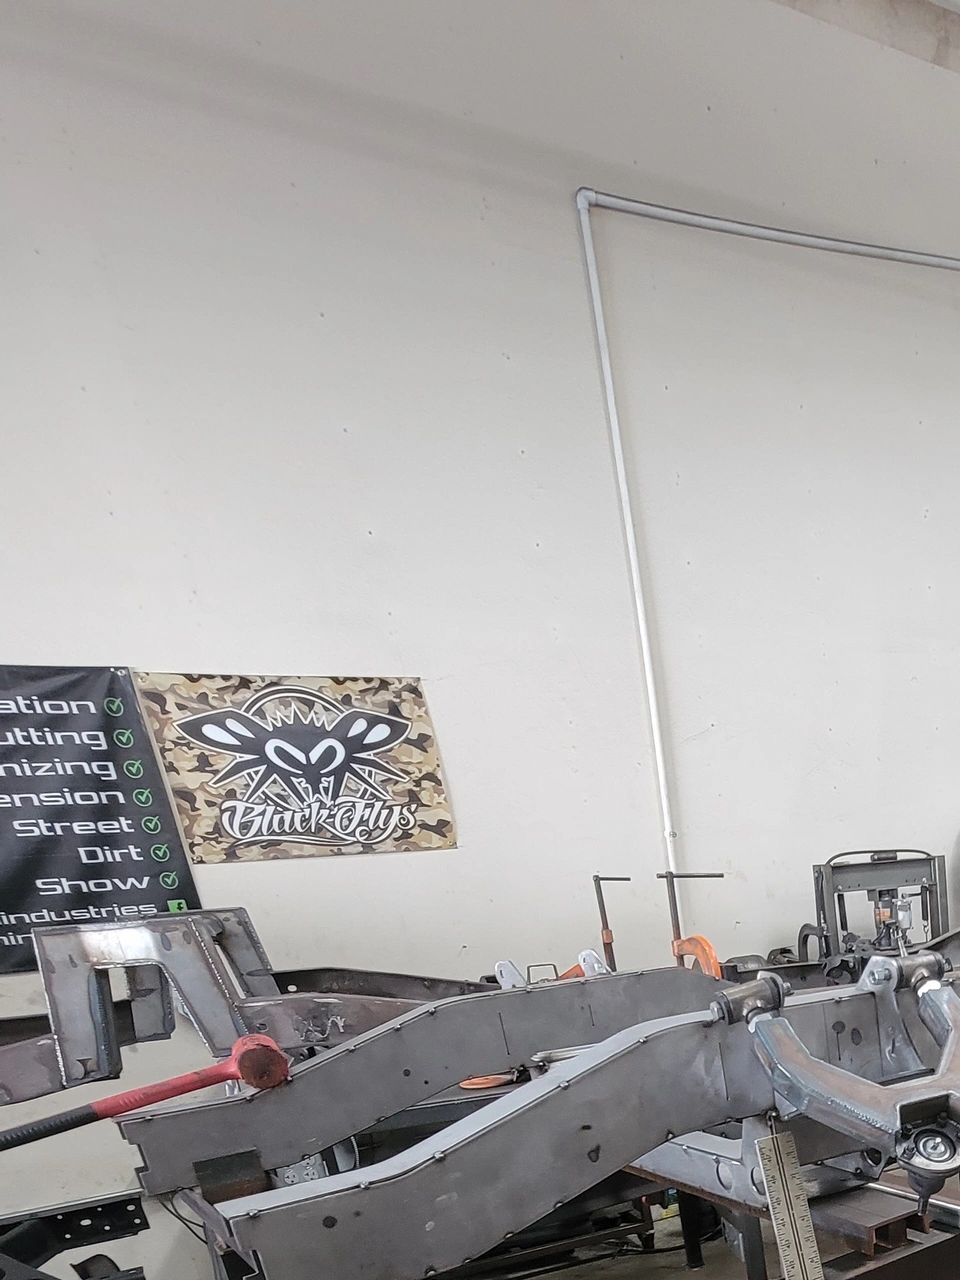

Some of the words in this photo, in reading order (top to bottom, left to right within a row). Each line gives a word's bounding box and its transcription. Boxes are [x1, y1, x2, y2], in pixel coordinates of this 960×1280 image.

[12, 816, 135, 837] Street
[221, 800, 348, 842] Black
[333, 796, 417, 843] Flys
[77, 845, 144, 864] Dirt
[35, 876, 150, 895] Show
[0, 903, 158, 926] industries
